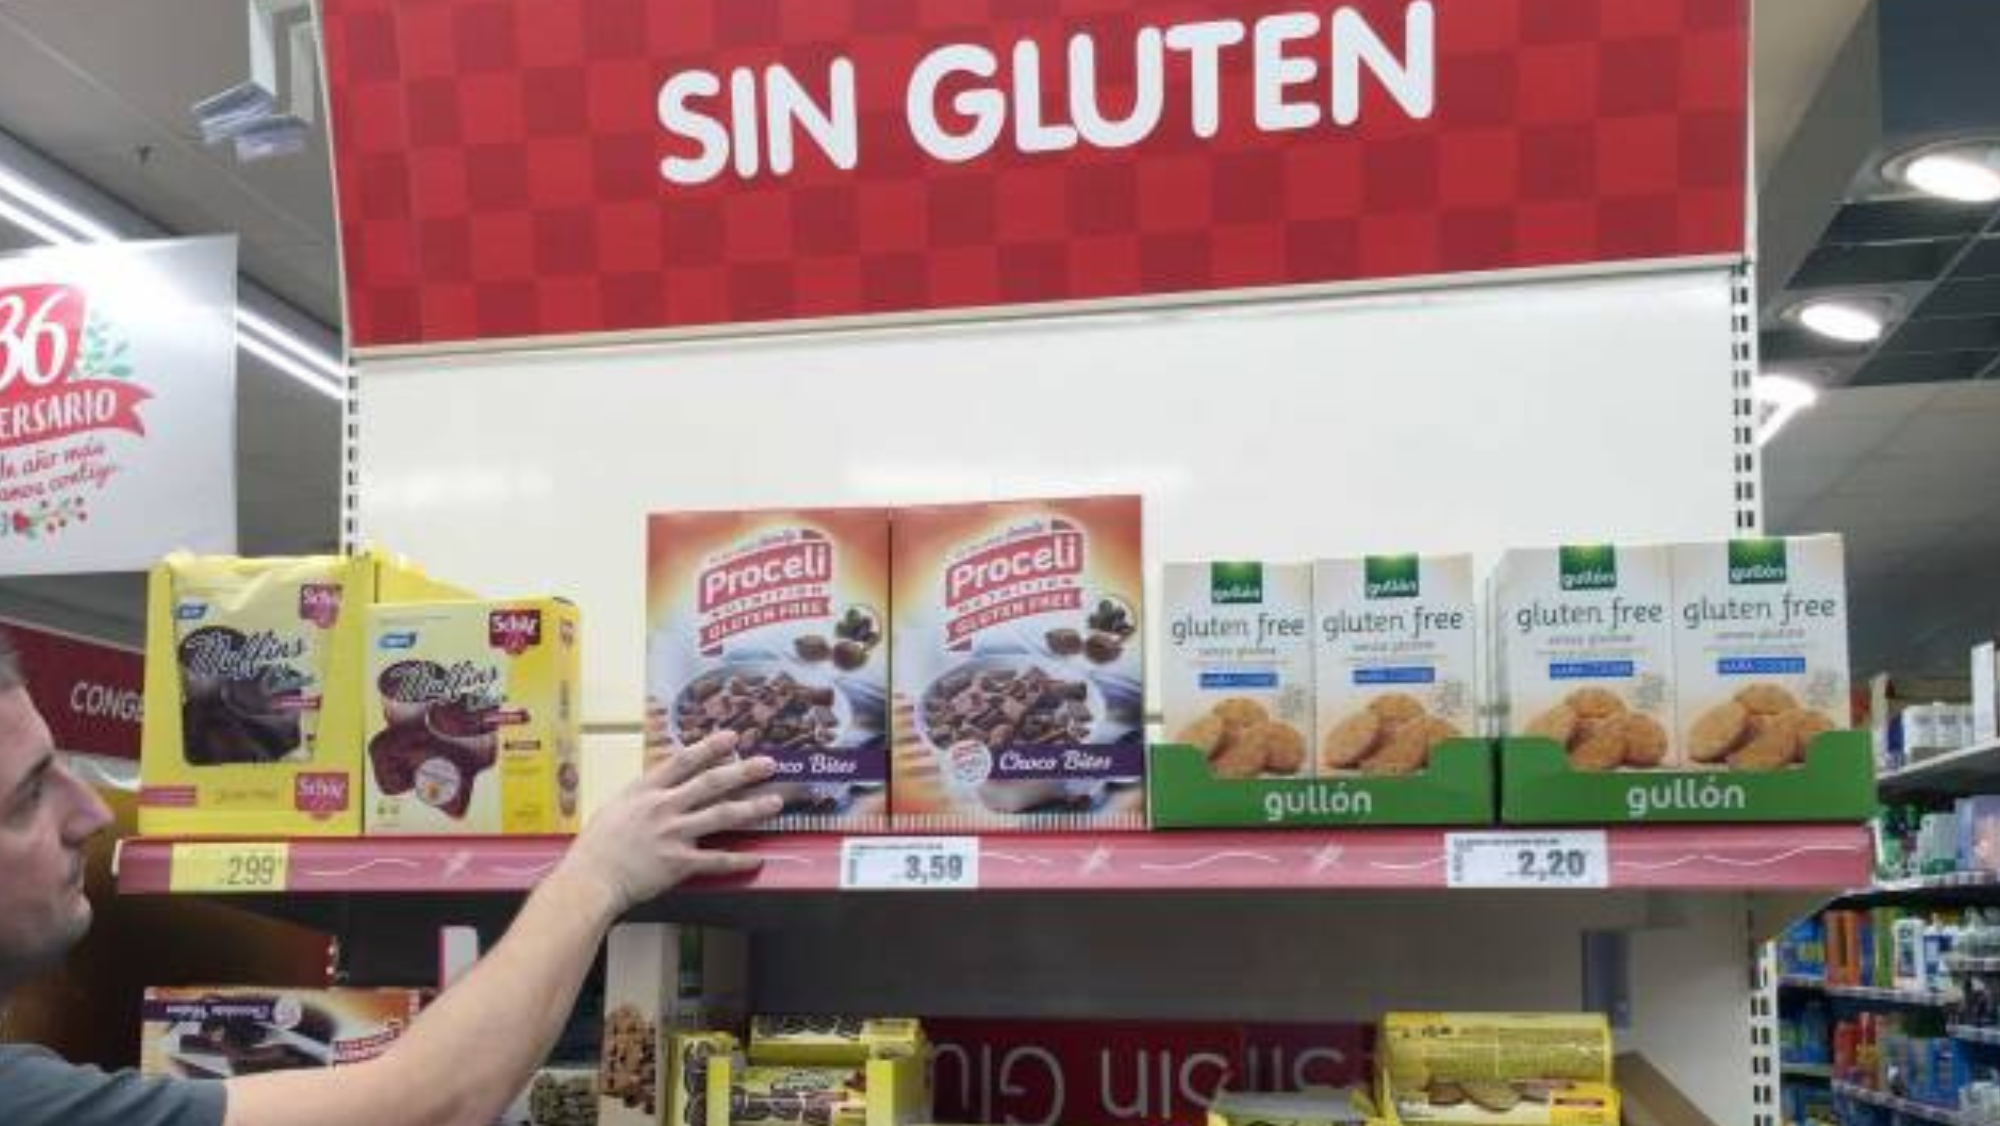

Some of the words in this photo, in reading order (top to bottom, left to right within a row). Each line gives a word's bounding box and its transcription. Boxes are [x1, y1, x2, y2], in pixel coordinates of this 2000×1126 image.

[658, 57, 857, 184] SIN
[906, 0, 1435, 163] GLUTEN
[705, 545, 826, 604] Proceli
[952, 535, 1077, 598] Proceli
[1172, 613, 1248, 645] gluten
[1257, 614, 1305, 642] free
[1322, 608, 1403, 642] gluten
[1412, 607, 1465, 638] free
[1516, 602, 1602, 634] gluten
[1613, 597, 1664, 629] free
[1683, 593, 1771, 631] gluten
[1783, 590, 1836, 625] free
[1000, 751, 1057, 770] Choco
[1061, 749, 1112, 770] Bites
[1264, 782, 1373, 822] gullón
[1626, 776, 1746, 818] gullón
[1518, 849, 1586, 882] 2,20
